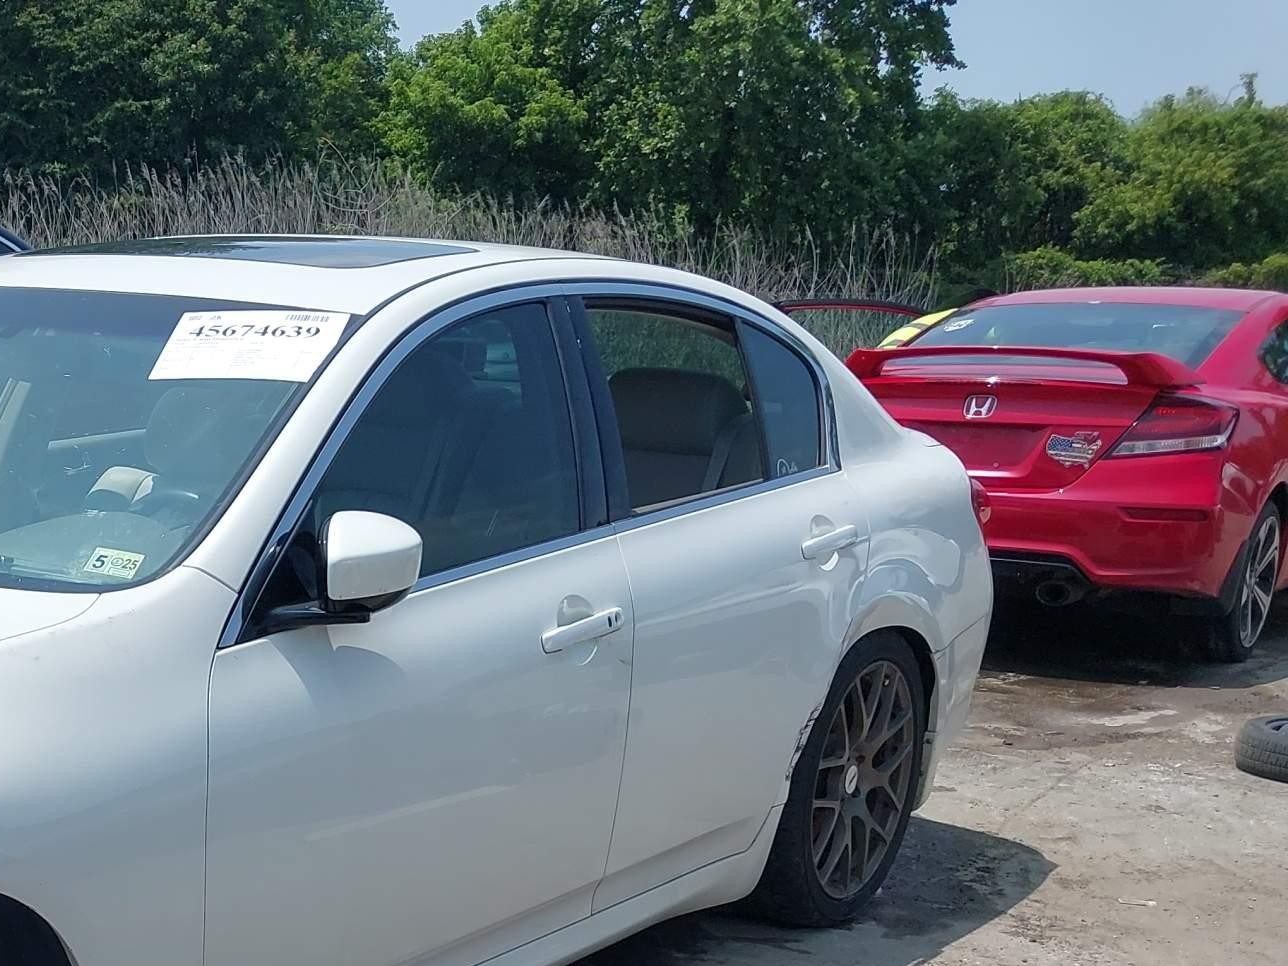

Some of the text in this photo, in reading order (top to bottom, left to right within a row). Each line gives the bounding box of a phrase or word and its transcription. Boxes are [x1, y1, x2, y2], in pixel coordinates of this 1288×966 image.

[189, 324, 321, 338] 45674639
[92, 554, 139, 570] 5 25
